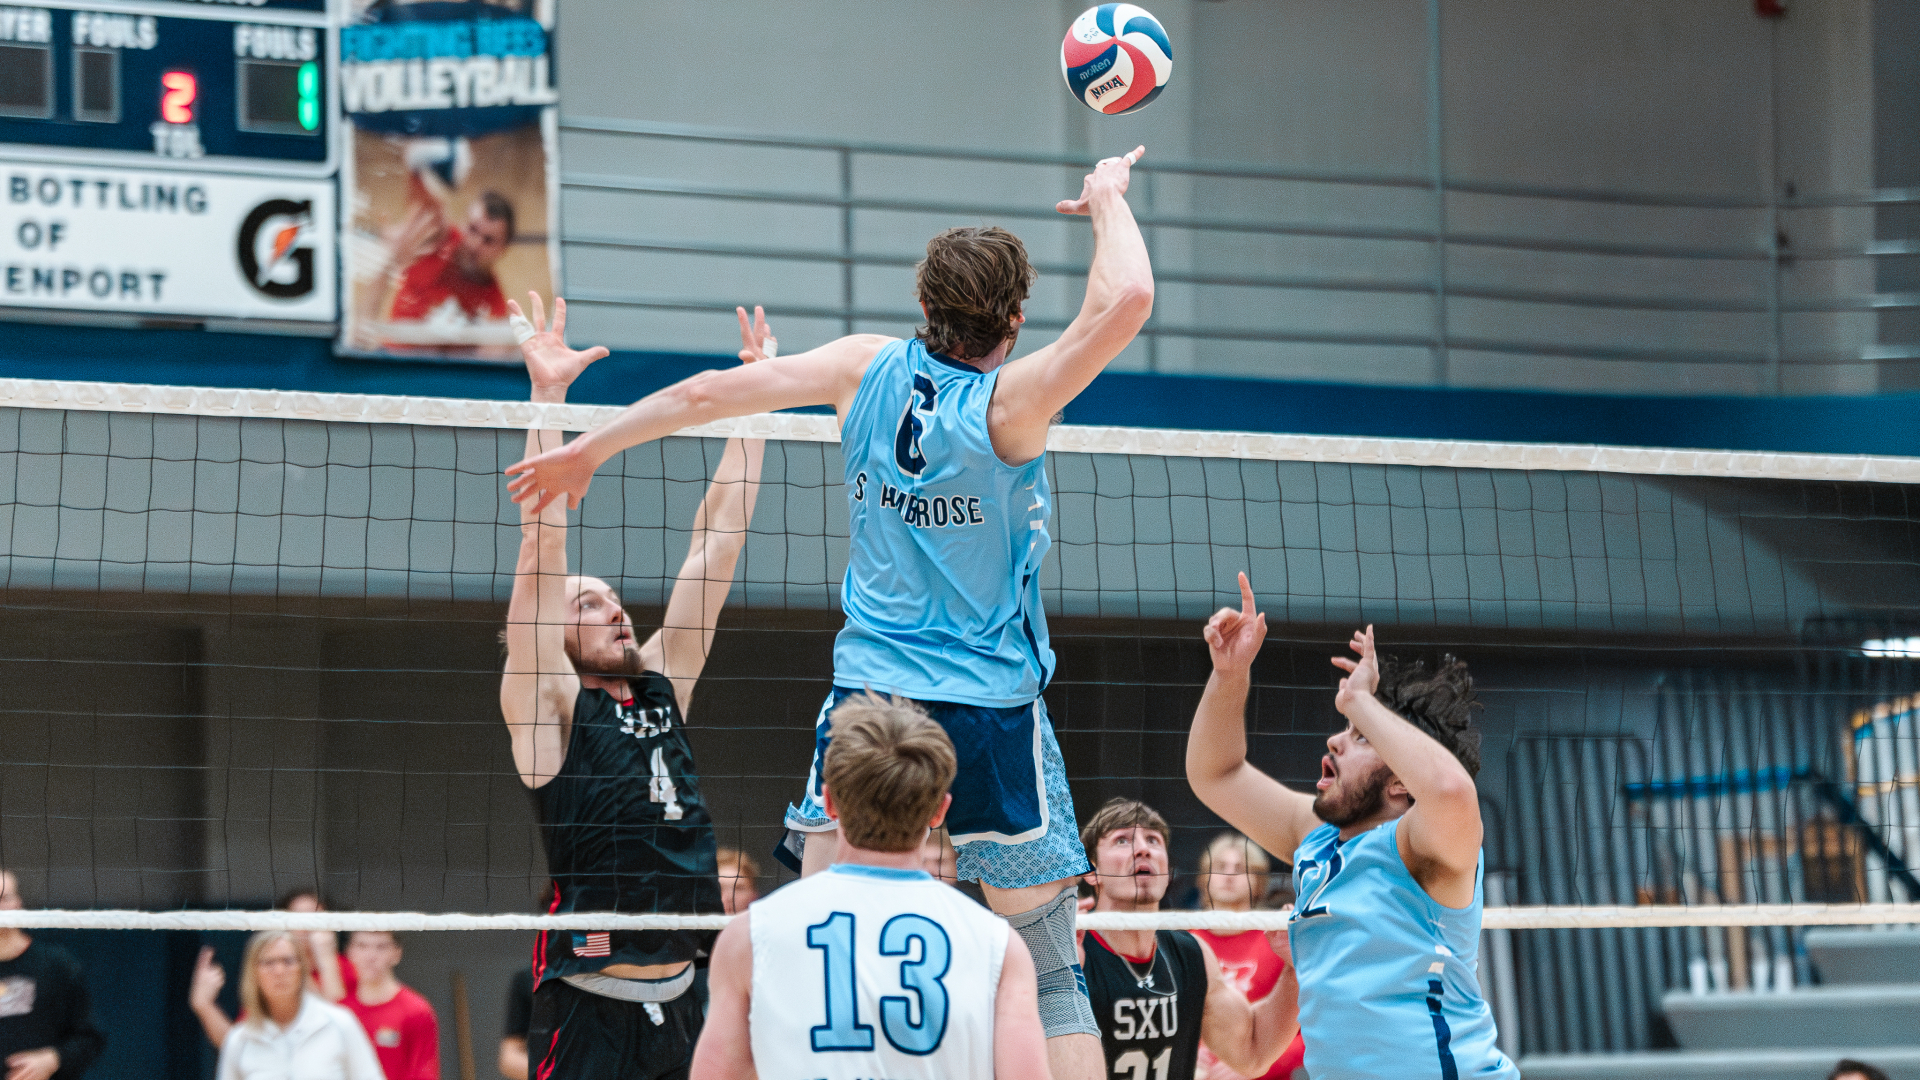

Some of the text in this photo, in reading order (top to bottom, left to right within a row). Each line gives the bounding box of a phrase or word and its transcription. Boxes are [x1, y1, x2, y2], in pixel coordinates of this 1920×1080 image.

[72, 12, 158, 50] FOULS
[234, 22, 318, 61] FOULS
[341, 53, 557, 113] VOLLEYBALL
[1079, 58, 1112, 81] molten
[1090, 77, 1125, 100] NAIA
[161, 71, 197, 124] 2
[297, 61, 319, 131] 1
[8, 175, 208, 215] BOTTLING
[17, 219, 67, 252] OF
[649, 747, 684, 820] 4
[806, 911, 953, 1056] 13
[1113, 994, 1178, 1041] SXU
